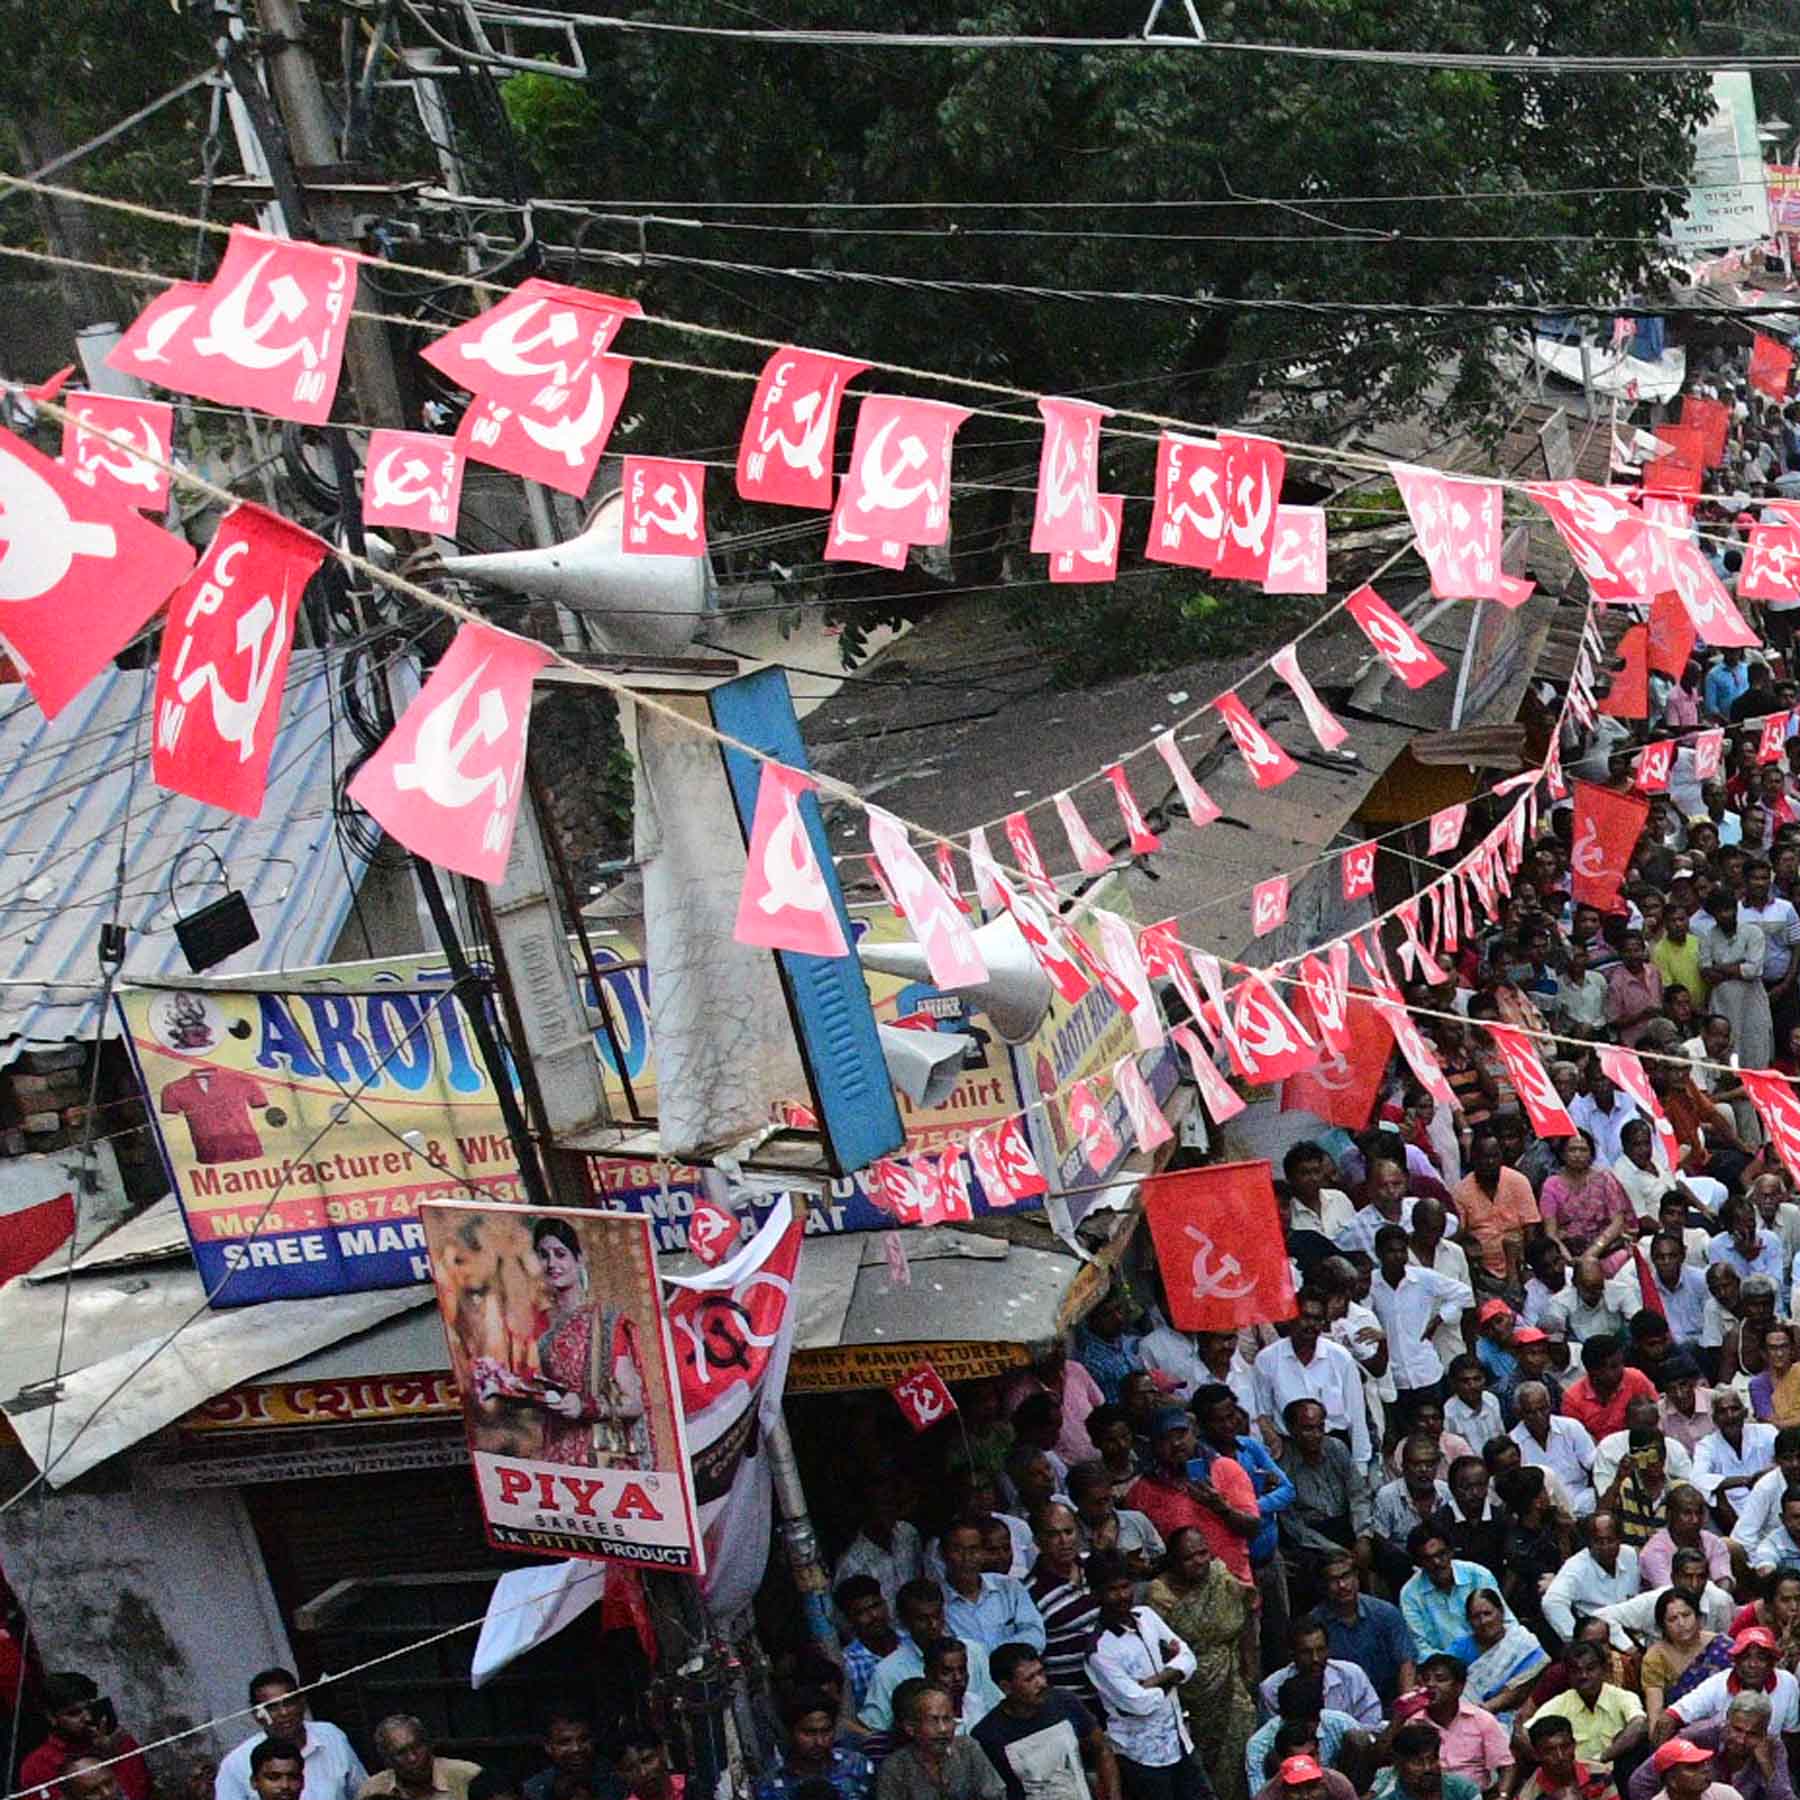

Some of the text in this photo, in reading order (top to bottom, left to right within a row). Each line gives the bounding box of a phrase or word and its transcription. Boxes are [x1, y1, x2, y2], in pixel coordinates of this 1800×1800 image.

[189, 1148, 413, 1196] Manufacturer
[426, 1140, 448, 1169] &
[223, 1235, 327, 1271] SREE
[495, 1466, 664, 1521] PIYA
[535, 1514, 625, 1537] SAREES
[601, 1541, 688, 1565] PRODUCT
